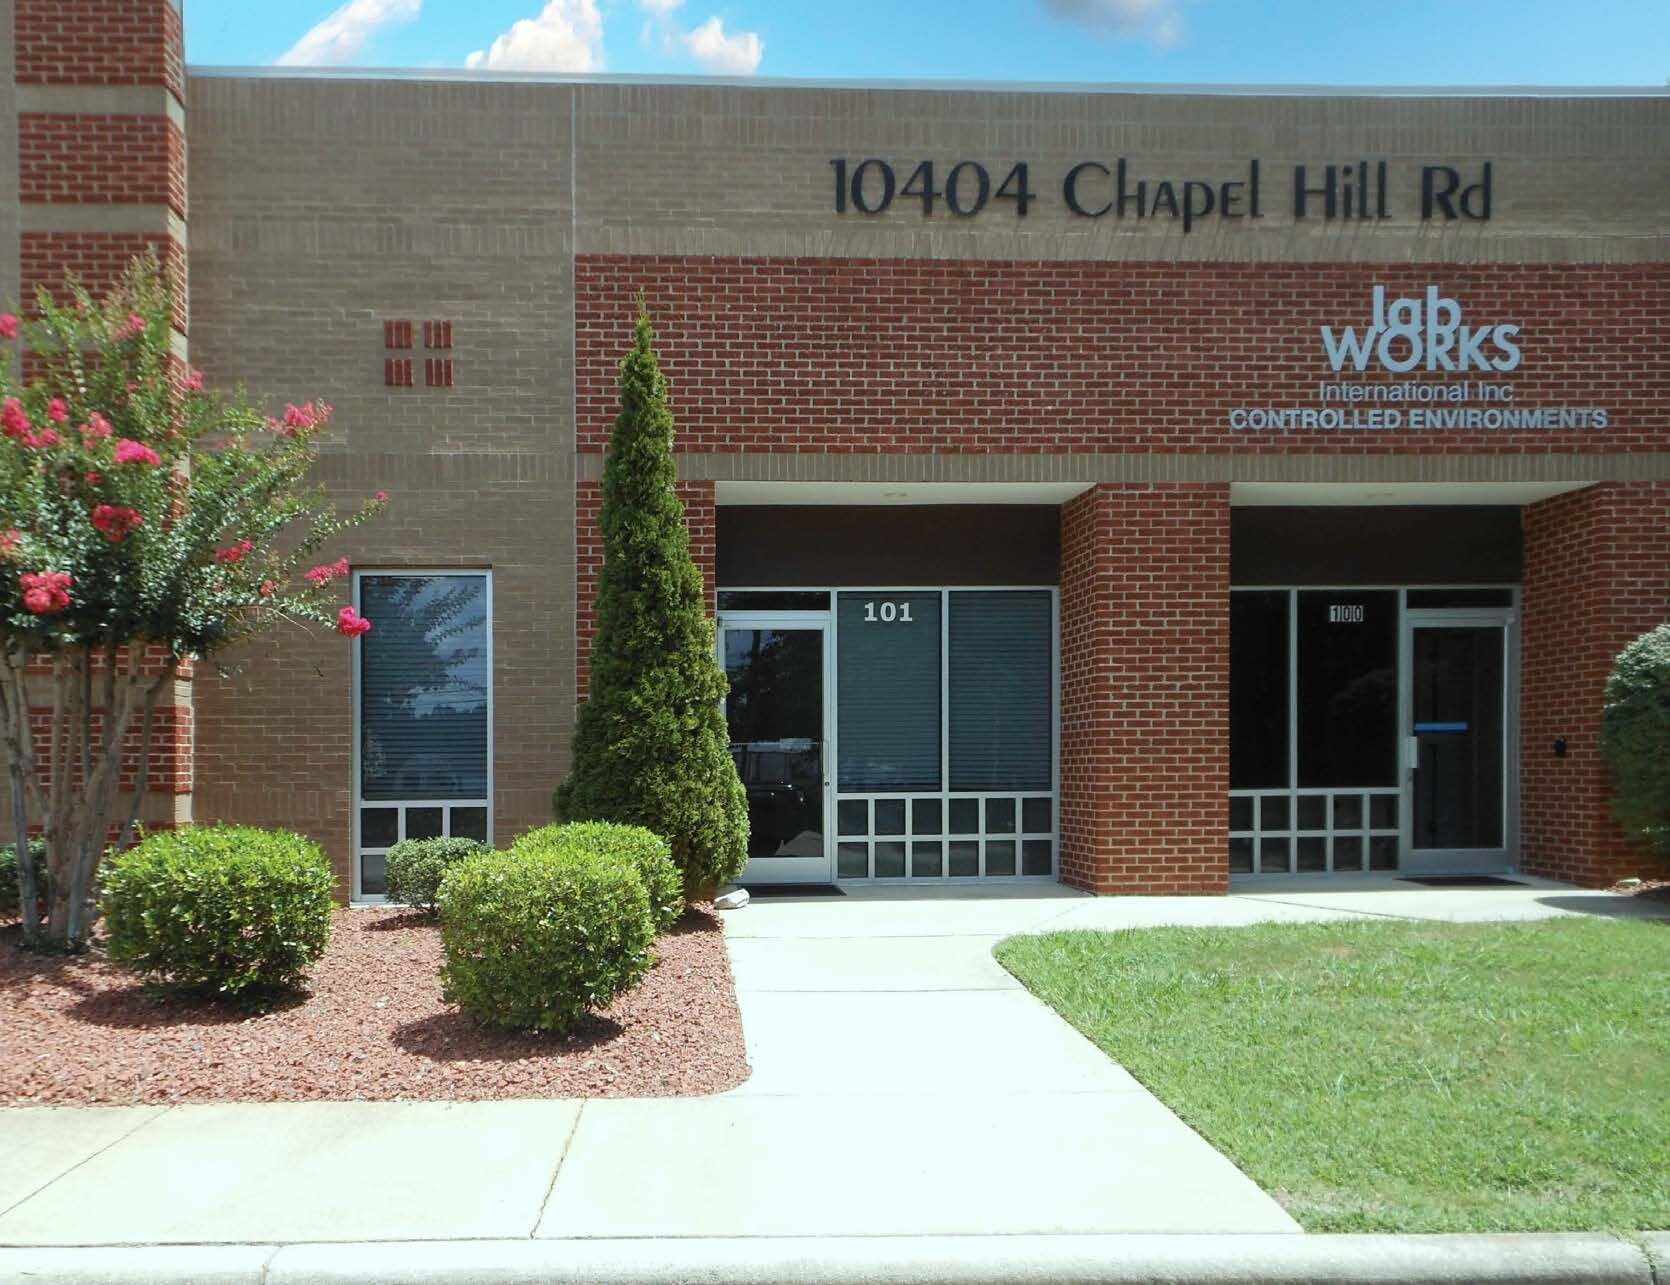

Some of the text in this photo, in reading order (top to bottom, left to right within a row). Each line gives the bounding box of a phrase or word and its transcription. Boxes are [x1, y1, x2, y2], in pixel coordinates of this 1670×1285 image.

[830, 157, 1036, 216] 10404
[1294, 160, 1392, 219] Hill
[1422, 161, 1491, 220] Rd
[1373, 285, 1462, 334] lab
[1320, 324, 1521, 372] WORKS
[1319, 381, 1468, 402] International
[1229, 408, 1608, 431] CONTROLLED ENVIRONMENTS
[863, 601, 913, 622] 101
[1329, 605, 1364, 622] 100
